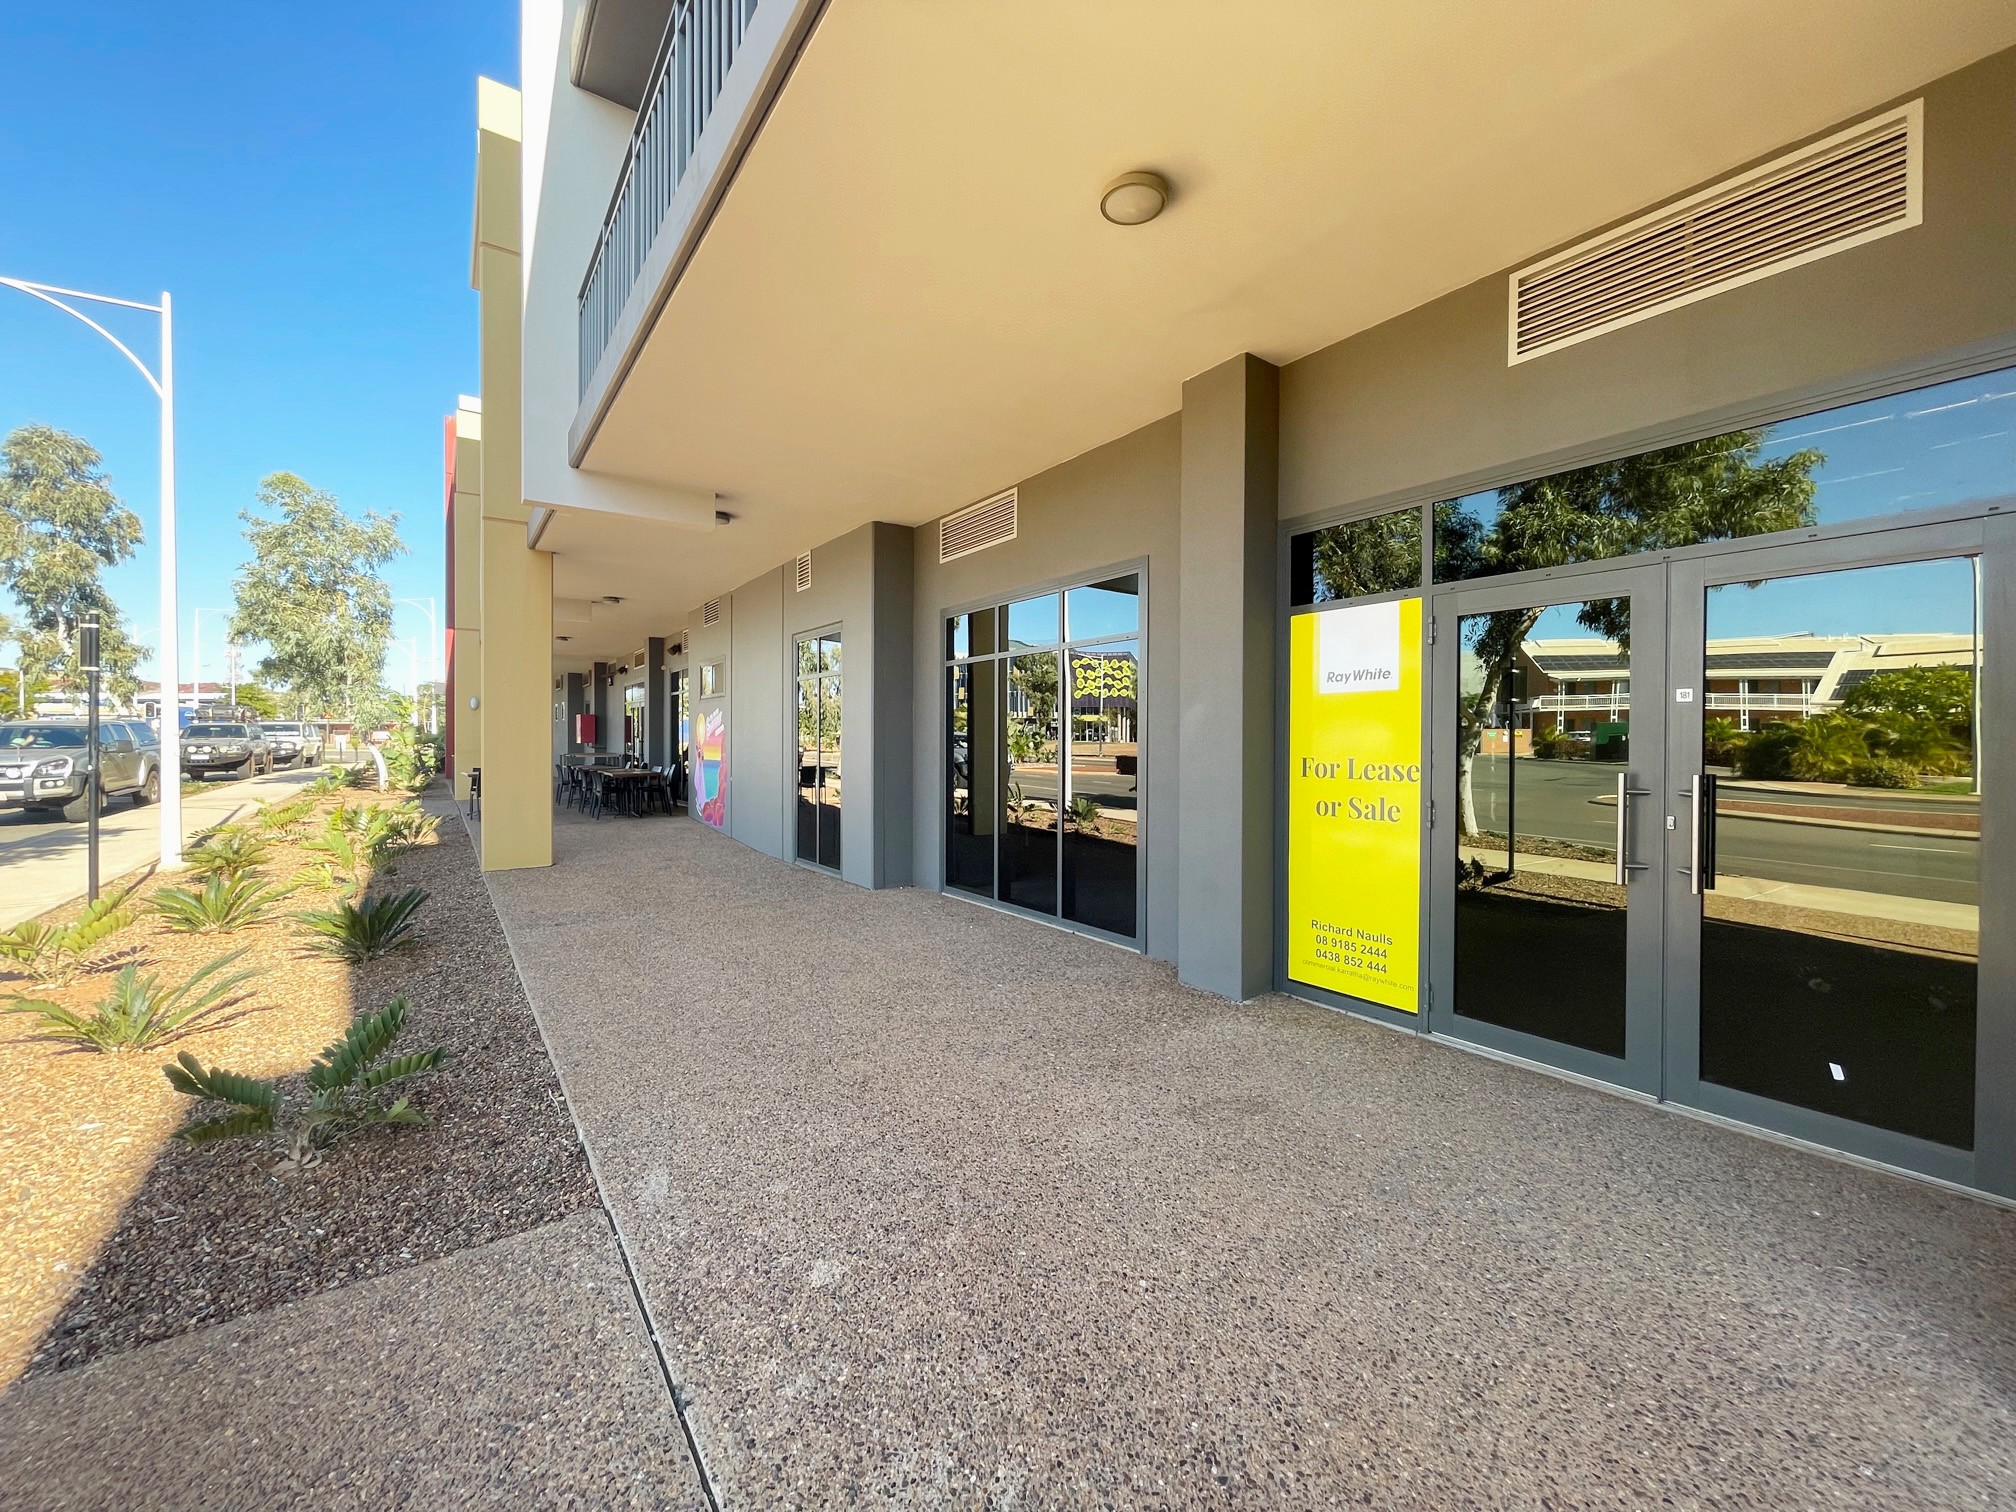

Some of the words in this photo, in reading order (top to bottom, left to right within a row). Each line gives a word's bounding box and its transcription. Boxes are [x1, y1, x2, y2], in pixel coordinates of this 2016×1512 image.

[1327, 671, 1352, 684] Ray
[1353, 668, 1392, 681] White
[1679, 691, 1690, 699] 181
[1301, 757, 1341, 779] For
[1347, 758, 1420, 782] Lease
[1315, 800, 1342, 817] or
[1348, 796, 1401, 823] Sale
[1311, 919, 1353, 938] Richard
[1356, 928, 1393, 946] Naulls
[1315, 934, 1328, 946] 08
[1331, 938, 1357, 953] 9185
[1360, 944, 1388, 959] 2444
[1315, 948, 1340, 963] 0438
[1343, 955, 1363, 969] 852
[1366, 960, 1388, 974] 444
